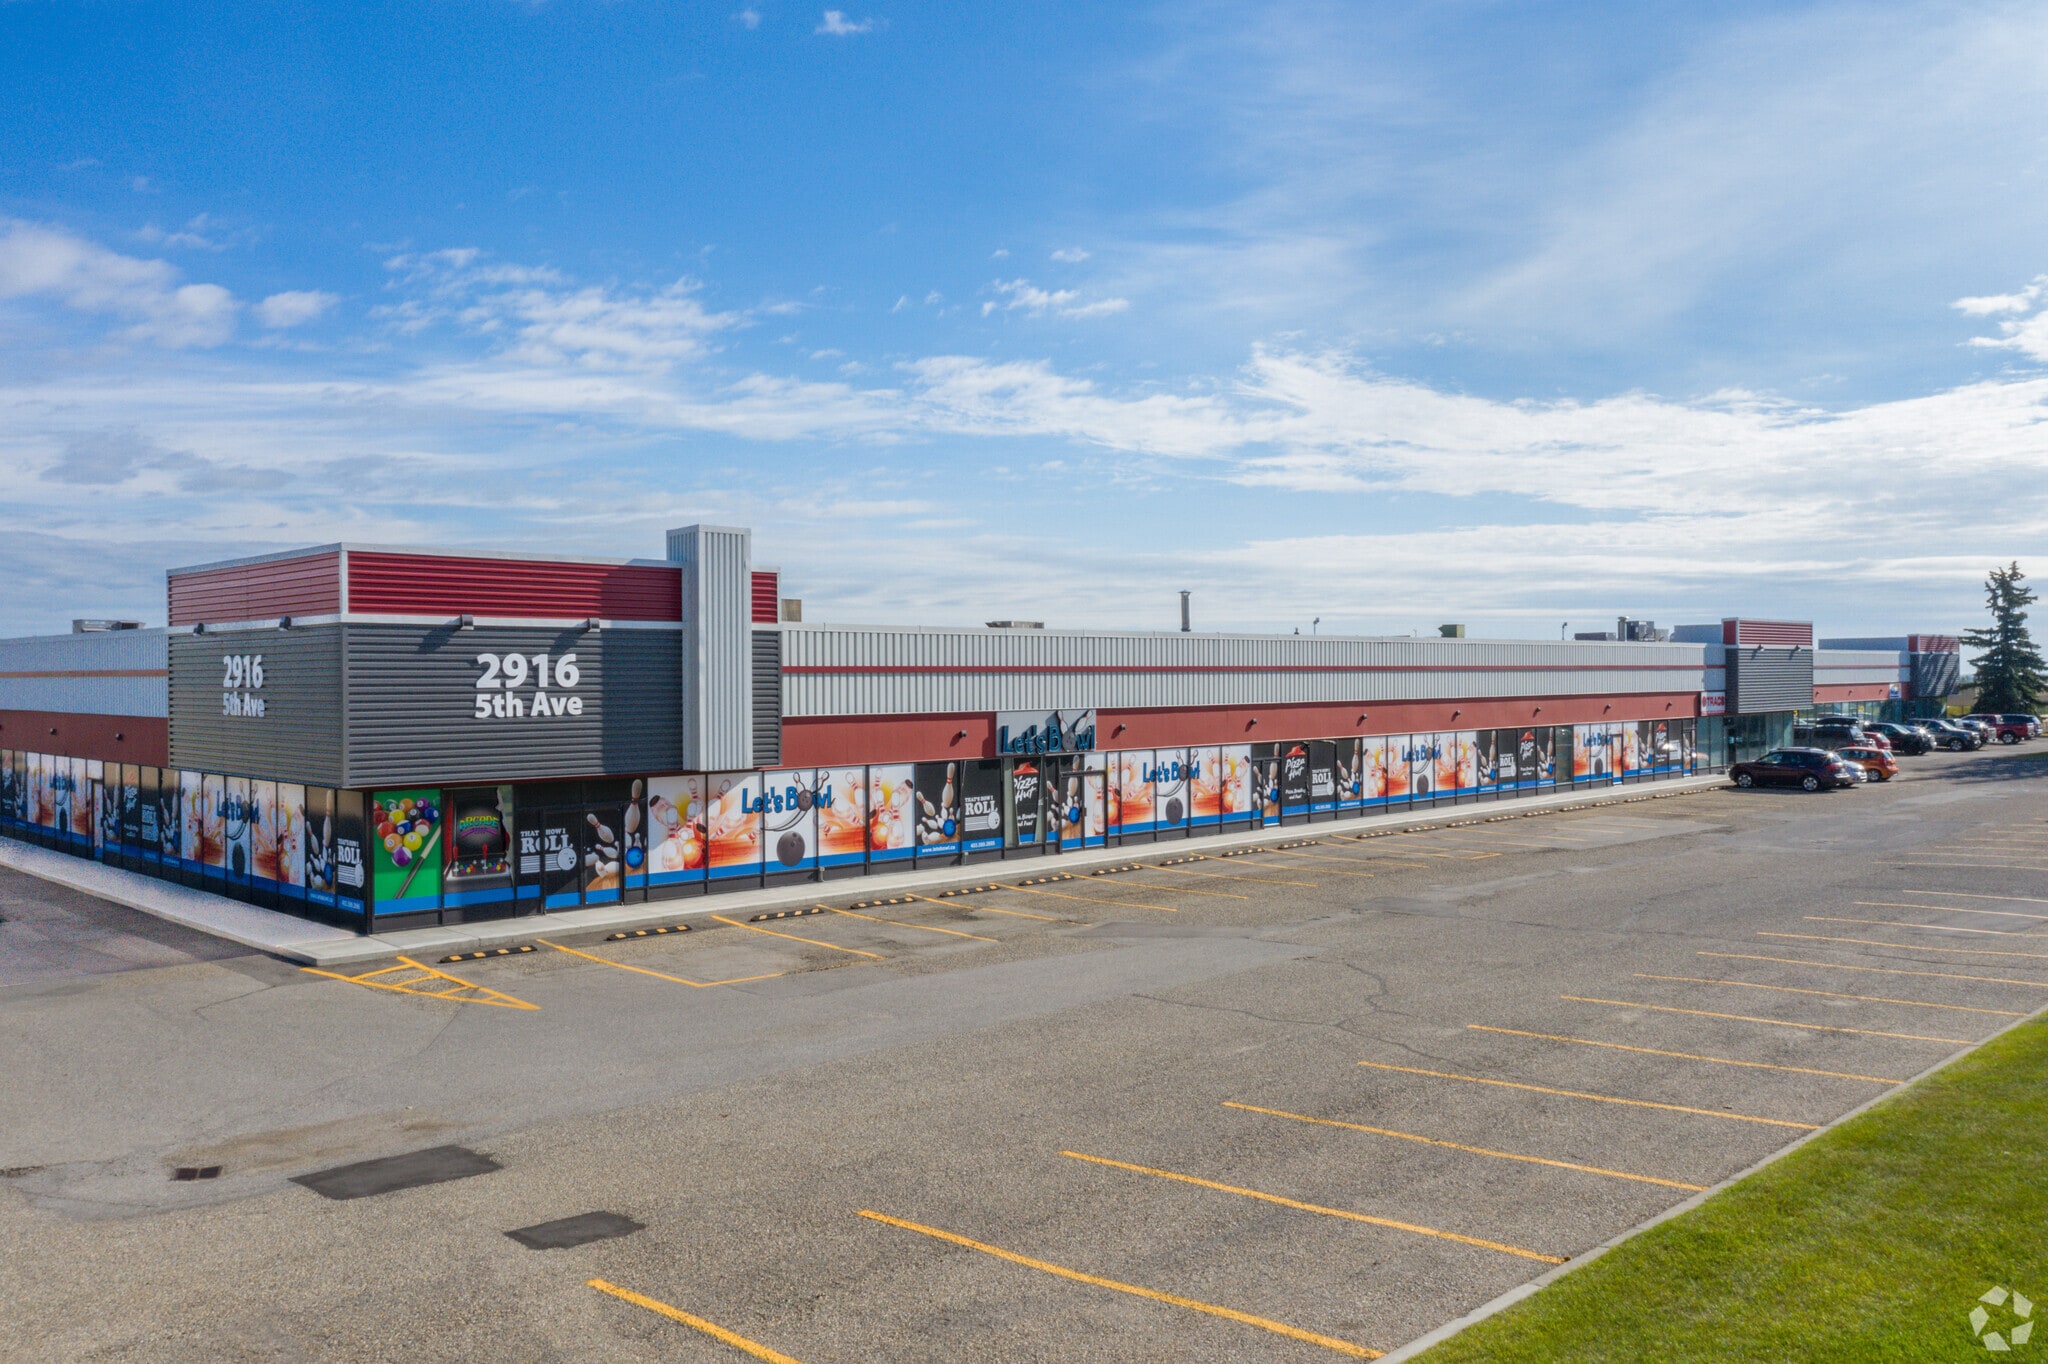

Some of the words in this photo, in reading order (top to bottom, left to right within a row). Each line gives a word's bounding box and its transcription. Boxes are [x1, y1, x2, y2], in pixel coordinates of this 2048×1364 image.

[223, 654, 264, 689] 2916
[476, 653, 580, 689] 2916
[223, 691, 241, 716] 5th
[243, 692, 265, 718] Ave
[475, 691, 524, 718] 5th
[530, 691, 584, 717] Ave
[1002, 724, 1046, 755] Let's
[1143, 761, 1170, 783] Let's
[1285, 756, 1306, 773] Pizza
[1288, 766, 1305, 781] Hut
[1312, 772, 1334, 784] ROLL
[742, 785, 784, 813] Let's
[1015, 786, 1037, 804] Hut
[965, 800, 998, 816] ROLL
[337, 845, 363, 864] ROLL
[520, 834, 574, 854] ROLL
